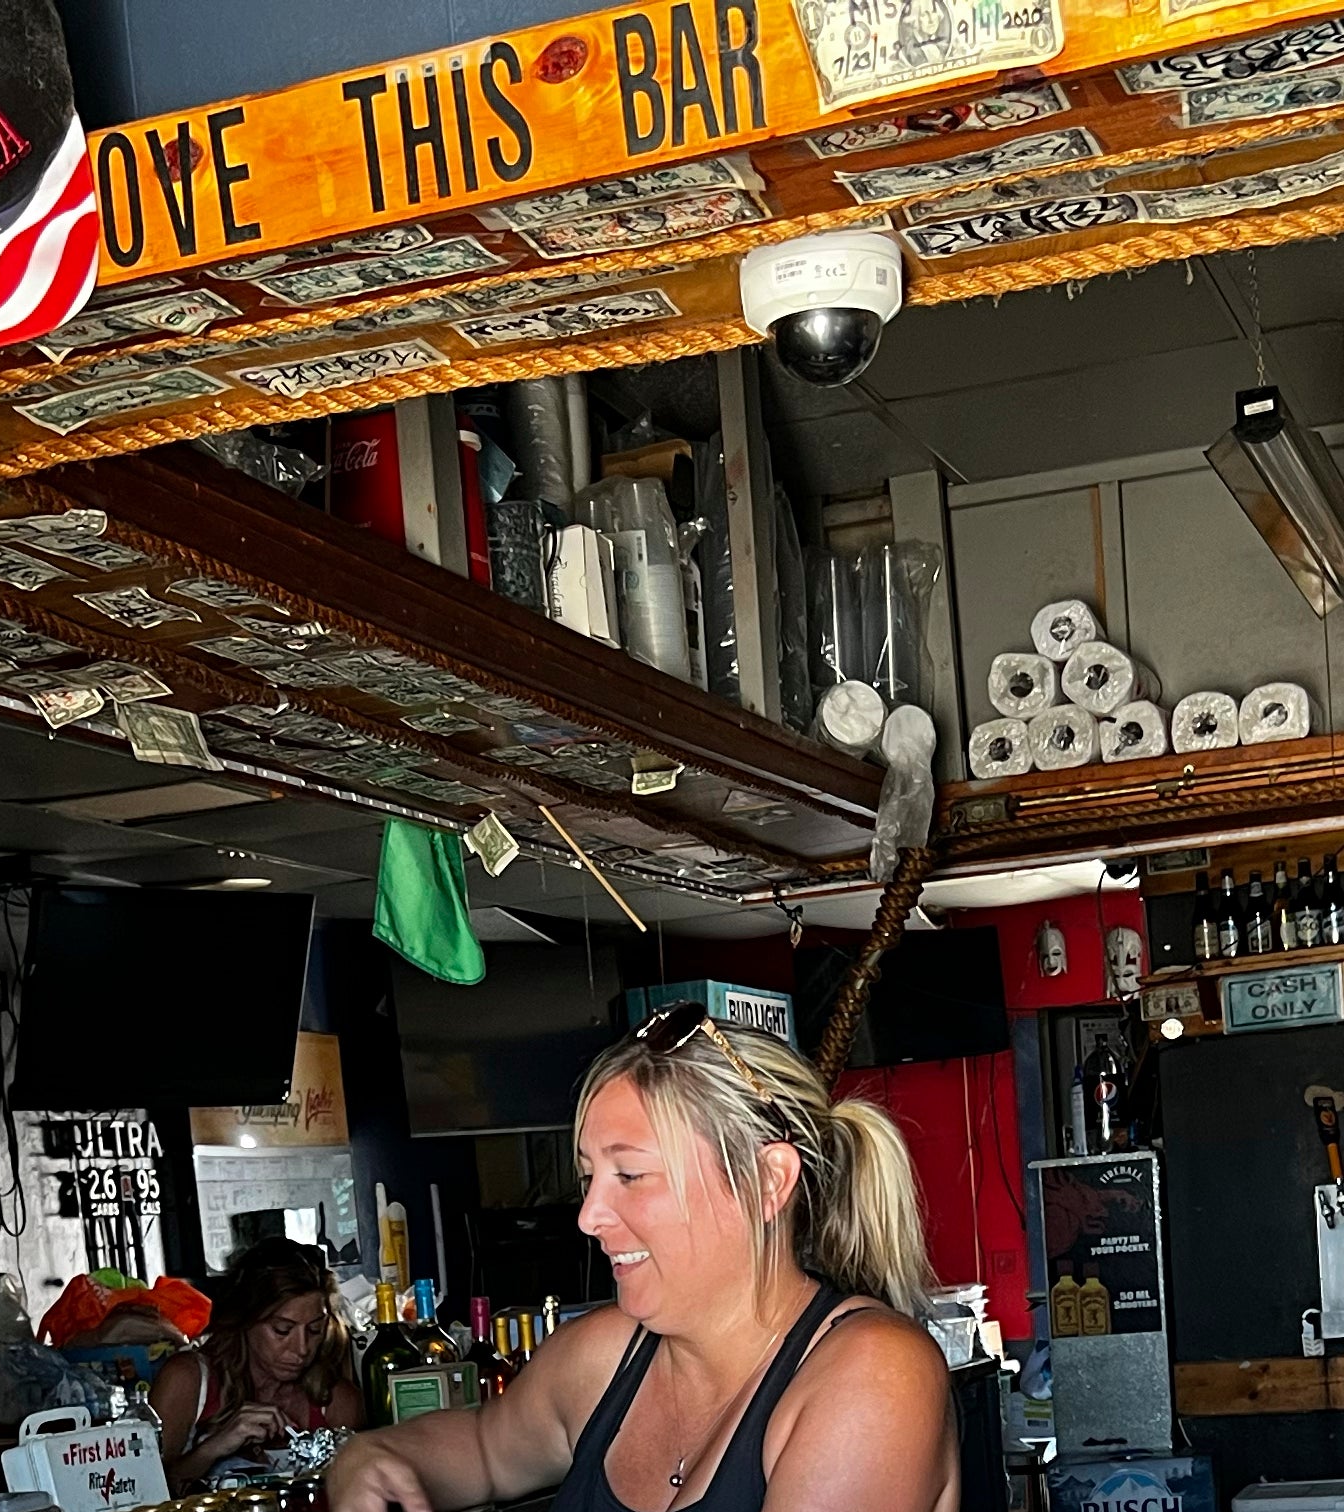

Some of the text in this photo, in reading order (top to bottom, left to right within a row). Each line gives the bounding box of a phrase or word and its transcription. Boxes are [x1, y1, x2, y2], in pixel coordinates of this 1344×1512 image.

[98, 0, 768, 268] OVE THIS BAR
[1247, 976, 1318, 998] CASH
[1251, 999, 1318, 1021] ONLY
[73, 1120, 164, 1159] ULTRA
[136, 1168, 161, 1200] 95
[69, 1437, 127, 1466] First Aid
